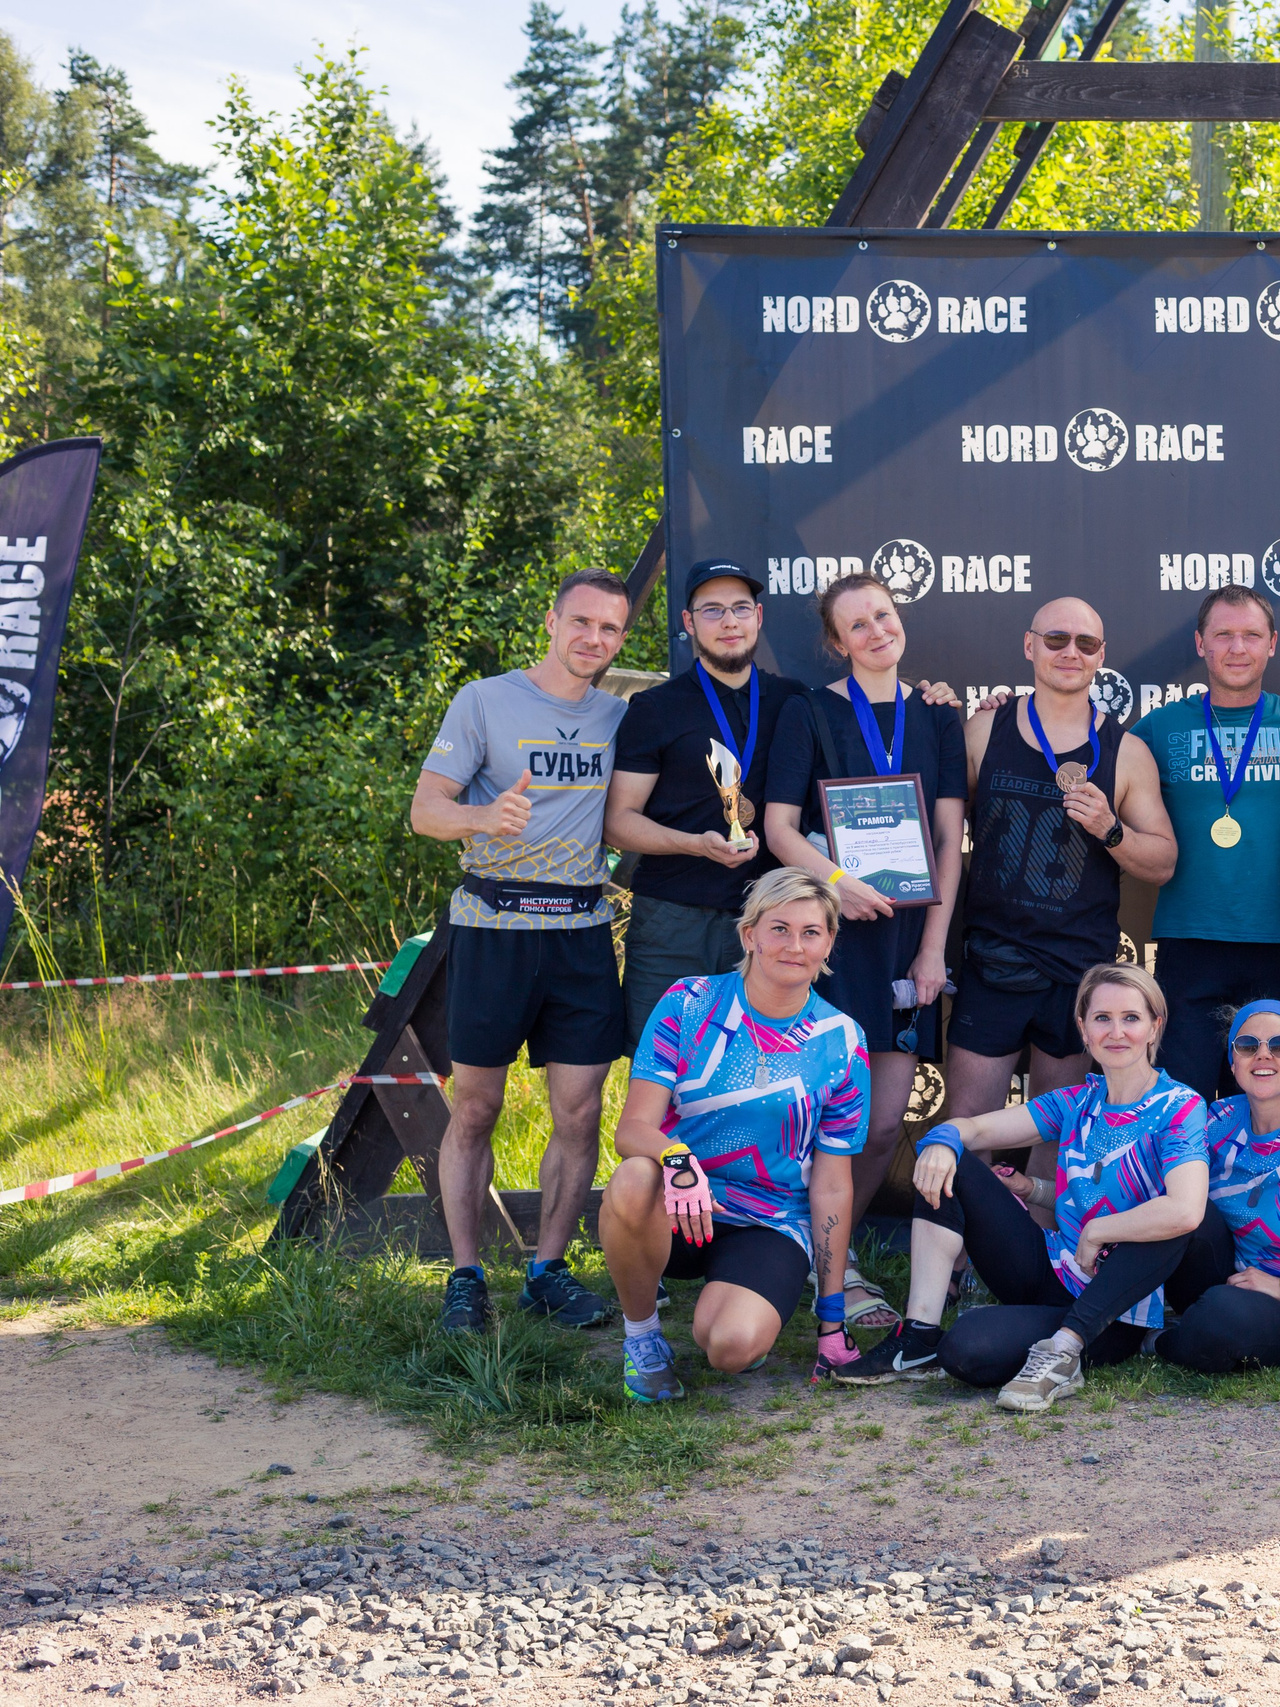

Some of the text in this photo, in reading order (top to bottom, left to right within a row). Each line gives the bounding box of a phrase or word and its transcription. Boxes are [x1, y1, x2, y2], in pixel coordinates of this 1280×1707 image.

[763, 296, 1027, 333] NORD RACE
[1155, 297, 1249, 333] NORD
[743, 425, 832, 463] RACE
[962, 424, 1224, 462] NORD RACE
[942, 555, 1031, 592] RACE
[1160, 553, 1254, 591] NORD
[529, 751, 603, 782] СУДЬЯ
[993, 778, 1040, 793] LEADER
[857, 815, 895, 826] ГРАМОТА
[520, 897, 574, 905] ИНСТРУКТОР
